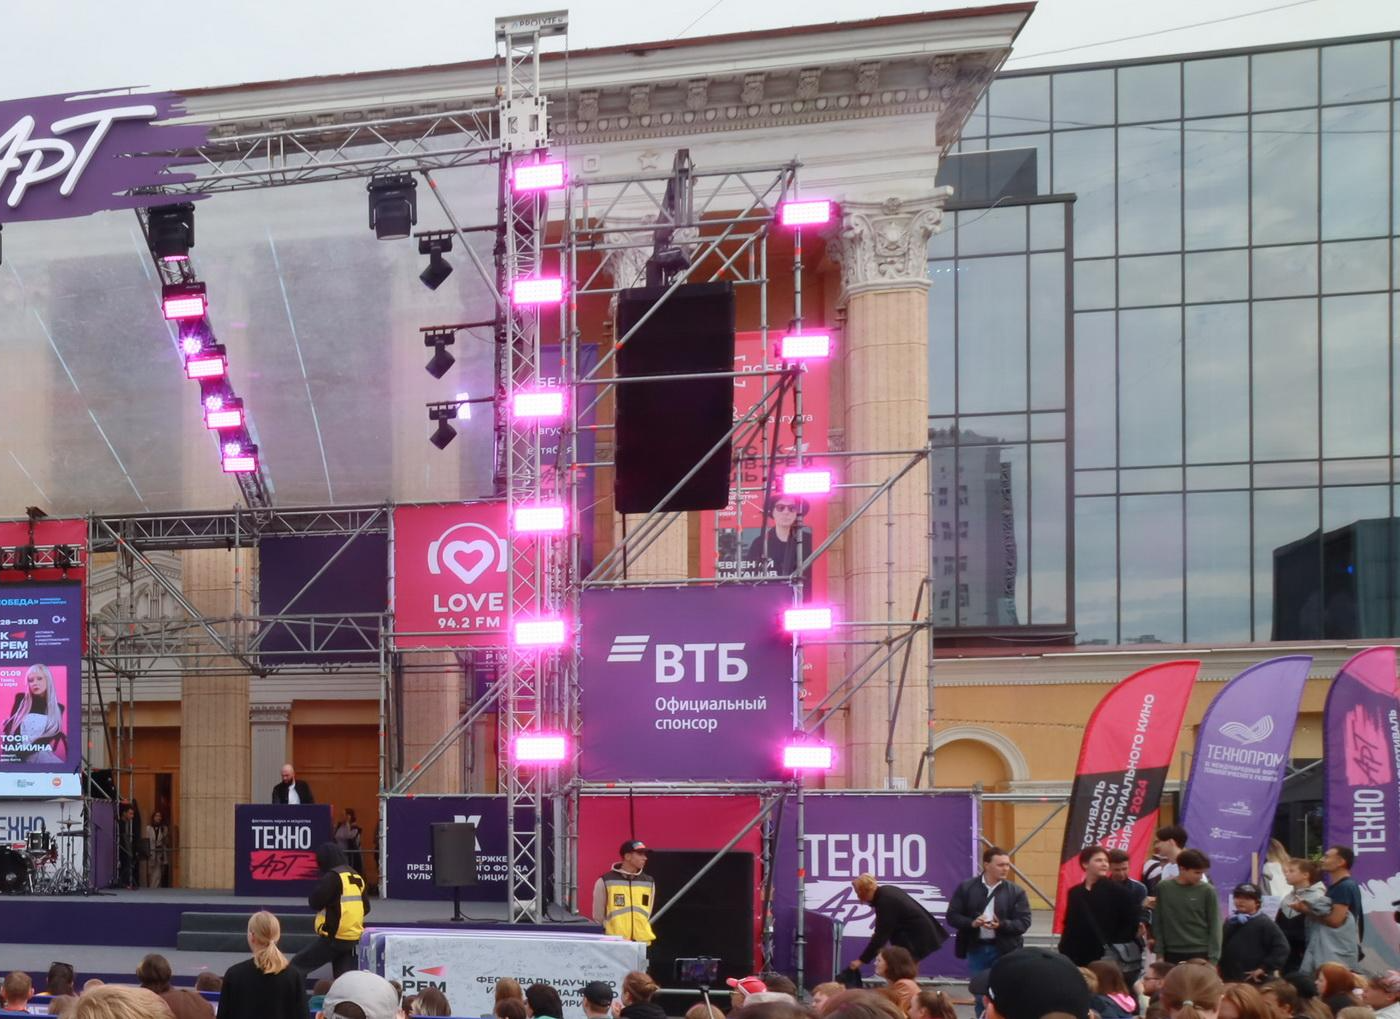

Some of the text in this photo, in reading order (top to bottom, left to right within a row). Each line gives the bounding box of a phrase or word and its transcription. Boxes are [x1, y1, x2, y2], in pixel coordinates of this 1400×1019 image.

[433, 592, 504, 613] LOVE
[438, 616, 501, 629] 94.2 FM
[0, 641, 28, 650] РЕМ
[0, 648, 28, 659] НИЙ
[655, 642, 748, 683] ВТБ
[655, 696, 767, 714] Официальный
[1136, 693, 1155, 733] КИНО
[655, 717, 718, 733] спонсор
[0, 734, 29, 742] ТОСЯ
[0, 742, 53, 752] ЧАЙКИНА
[1207, 744, 1284, 768] ТЕХНОПРОМ
[1129, 779, 1148, 815] 2024
[1352, 789, 1387, 857] ТЕХНО
[251, 826, 312, 850] ТЕХНО
[803, 833, 927, 877] ТЕХНО
[402, 965, 416, 977] К
